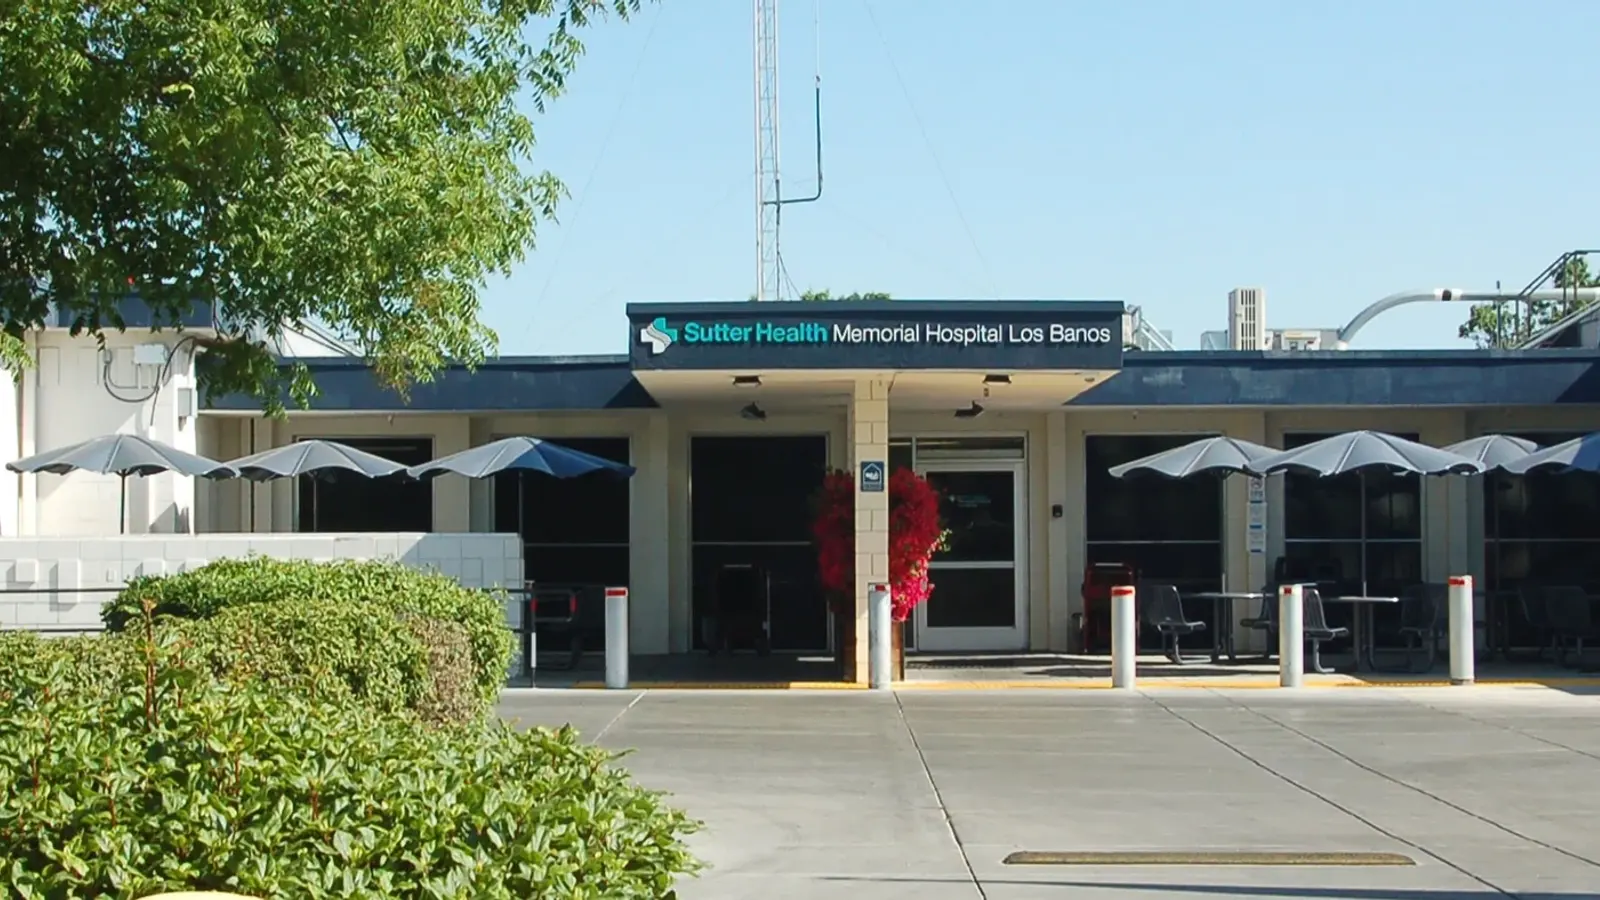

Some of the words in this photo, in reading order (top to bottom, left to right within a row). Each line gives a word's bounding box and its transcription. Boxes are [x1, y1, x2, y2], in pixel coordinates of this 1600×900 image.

[684, 322, 752, 343] Sutter
[756, 322, 828, 343] Health
[833, 323, 920, 343] Memorial
[925, 323, 1003, 347] Hospital
[1009, 324, 1045, 343] Los
[1050, 324, 1111, 343] Banos
